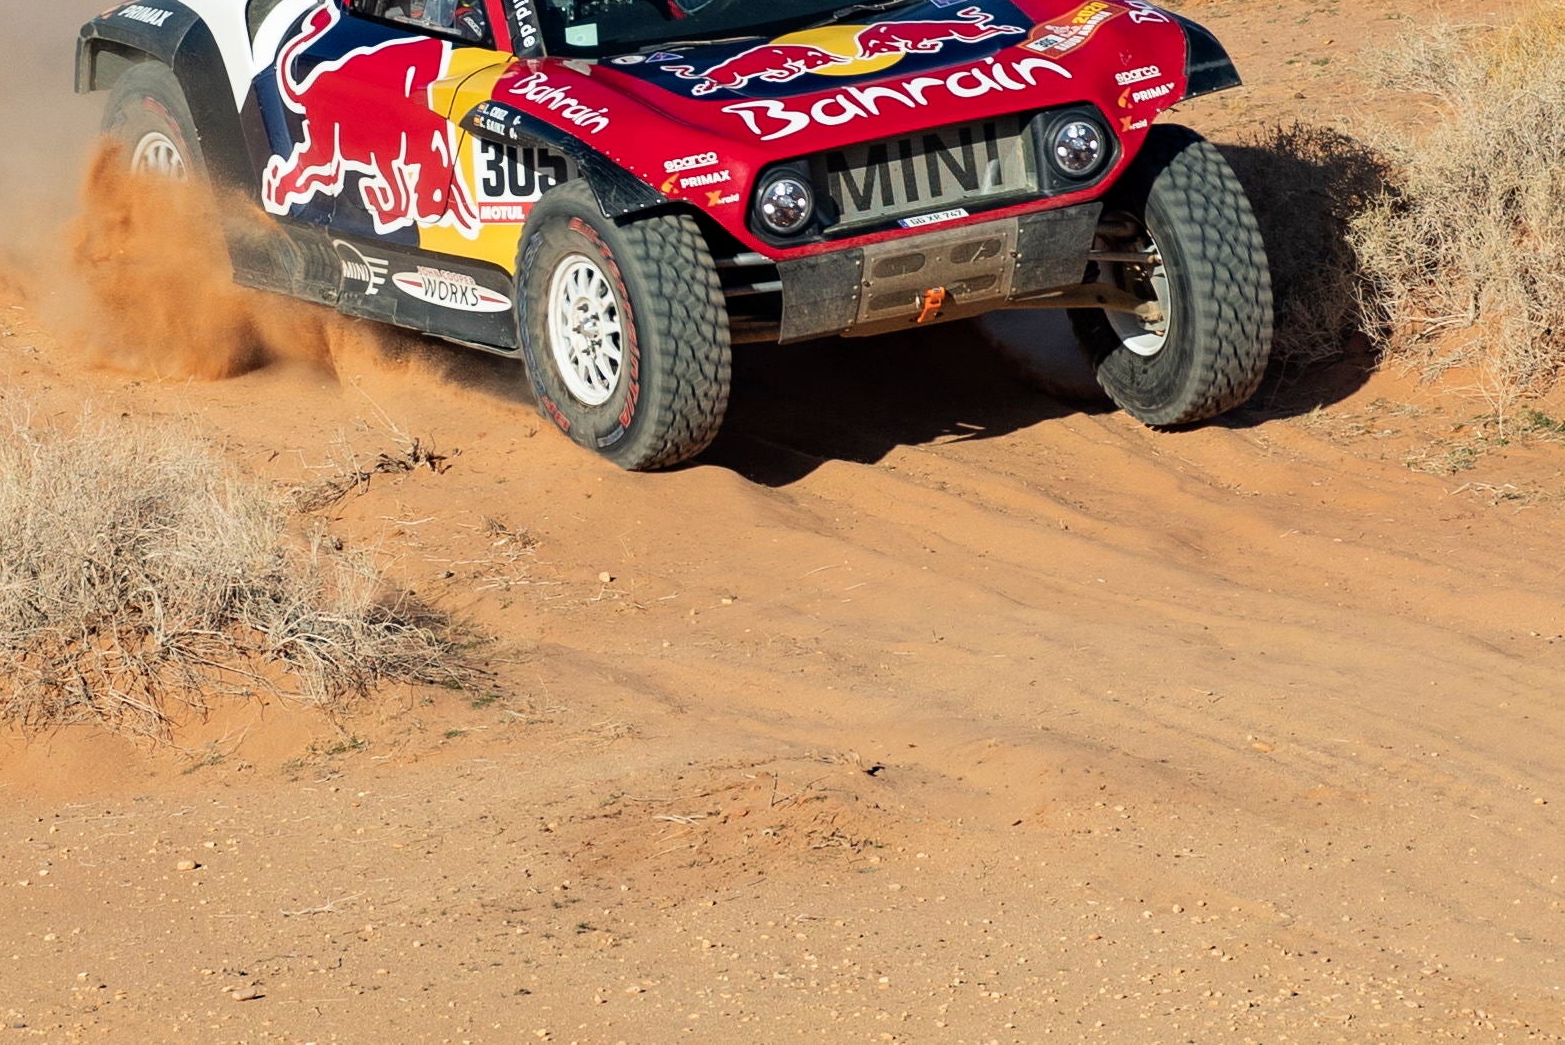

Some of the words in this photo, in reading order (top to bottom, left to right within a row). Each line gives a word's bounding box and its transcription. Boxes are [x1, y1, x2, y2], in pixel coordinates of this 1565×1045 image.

[117, 4, 174, 27] PRIMAX
[1071, 1, 1109, 25] 2020
[1115, 65, 1162, 85] sparco
[508, 72, 609, 134] Bahrain
[721, 56, 1073, 141] Bahrain
[480, 138, 568, 197] 305
[664, 151, 719, 173] sparco
[827, 122, 1004, 215] MINI
[680, 170, 731, 189] PRIMAX
[480, 205, 525, 220] MOTUL
[341, 260, 370, 282] MINI
[421, 276, 479, 307] WORKS
